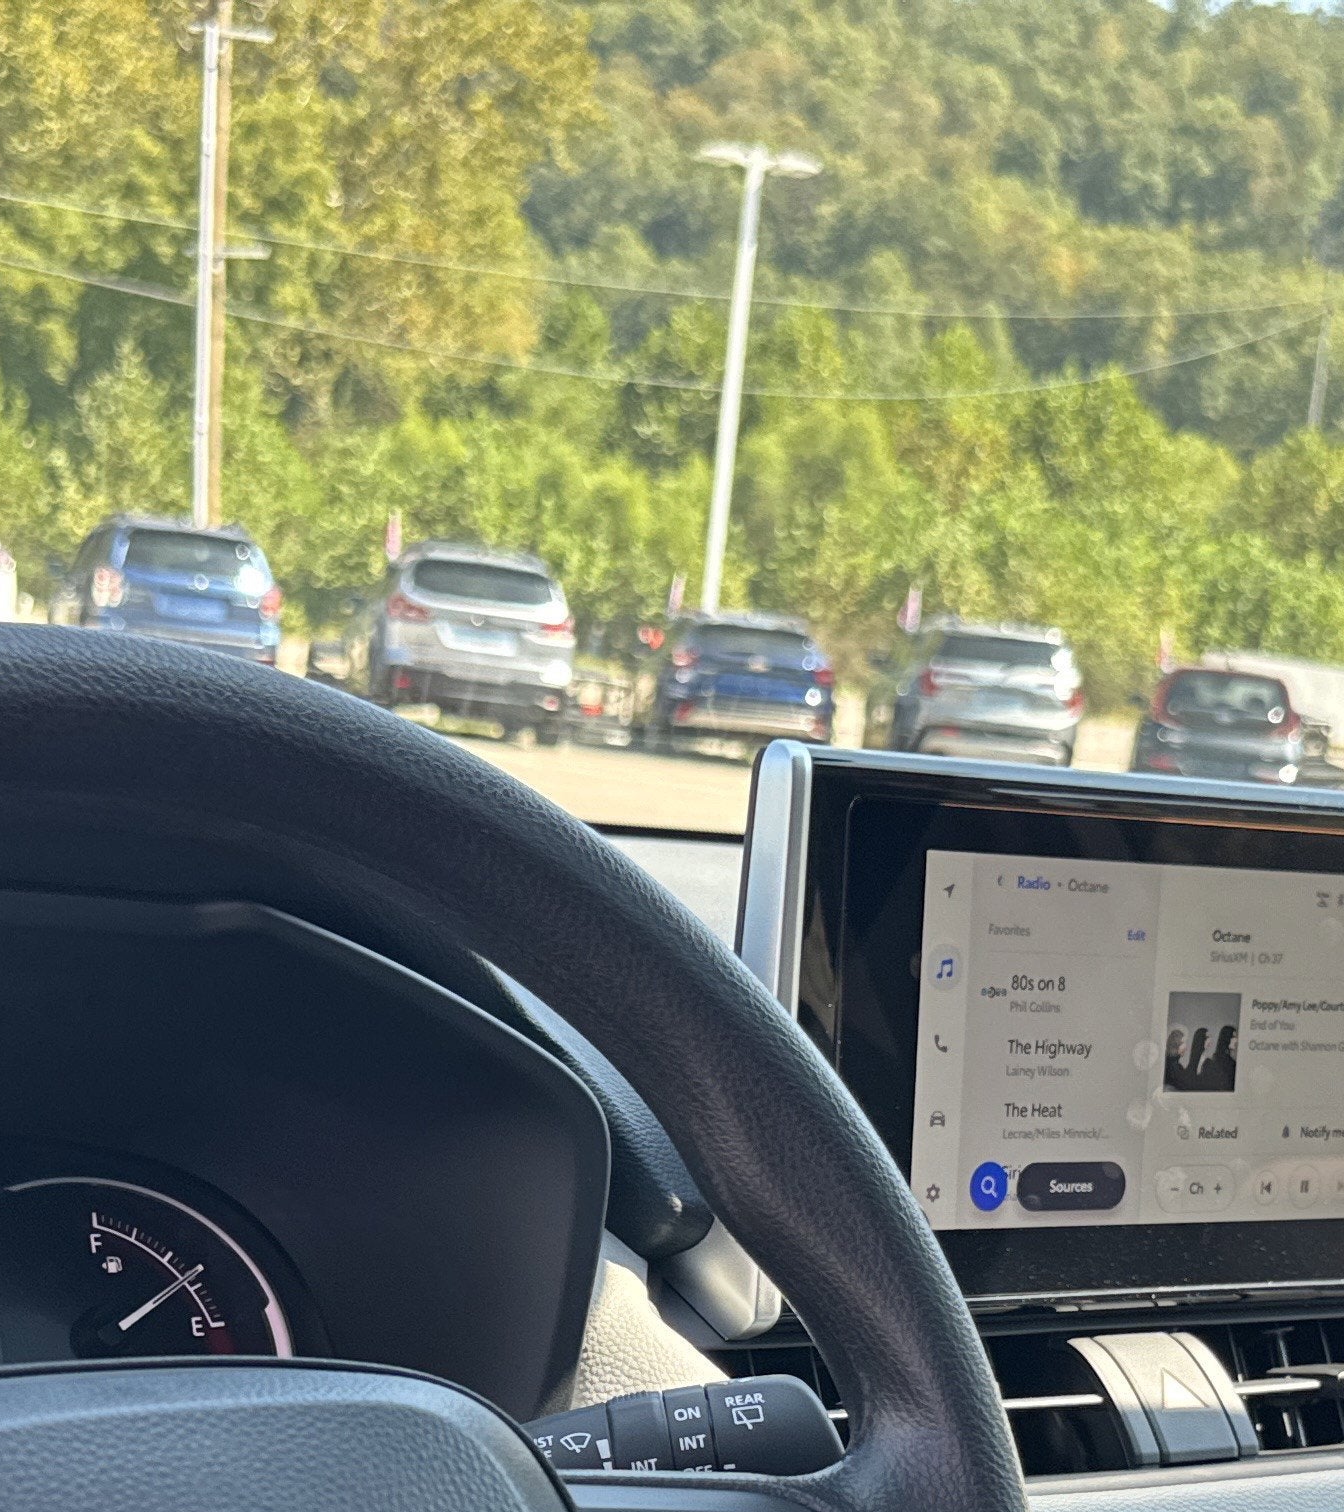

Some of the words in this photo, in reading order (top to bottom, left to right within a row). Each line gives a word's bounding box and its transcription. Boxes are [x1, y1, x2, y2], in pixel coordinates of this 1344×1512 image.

[1017, 876, 1051, 890] Radio
[1068, 878, 1110, 894] Octane
[988, 924, 1031, 937] Favorites
[1127, 930, 1146, 941] Edit
[1212, 929, 1251, 943] Octane
[1011, 975, 1034, 991] 80s
[1037, 978, 1055, 991] on
[1058, 976, 1066, 991] 8
[1009, 1002, 1027, 1013] Phil
[1029, 1002, 1061, 1013] Collins
[1008, 1040, 1032, 1055] The
[1034, 1040, 1093, 1059] Highway
[1005, 1066, 1036, 1079] Lainey
[1037, 1066, 1070, 1078] Wilson
[1004, 1103, 1028, 1118] The
[1031, 1103, 1063, 1118] Heat
[1198, 1126, 1239, 1139] Related
[1300, 1125, 1330, 1141] Notify
[1049, 1179, 1094, 1194] Sources
[1189, 1182, 1204, 1195] Ch
[90, 1234, 103, 1253] F
[191, 1317, 205, 1337] E
[725, 1393, 765, 1408] REAR
[674, 1406, 702, 1422] ON
[533, 1435, 554, 1449] IST
[679, 1433, 707, 1451] INT
[631, 1458, 658, 1472] INT
